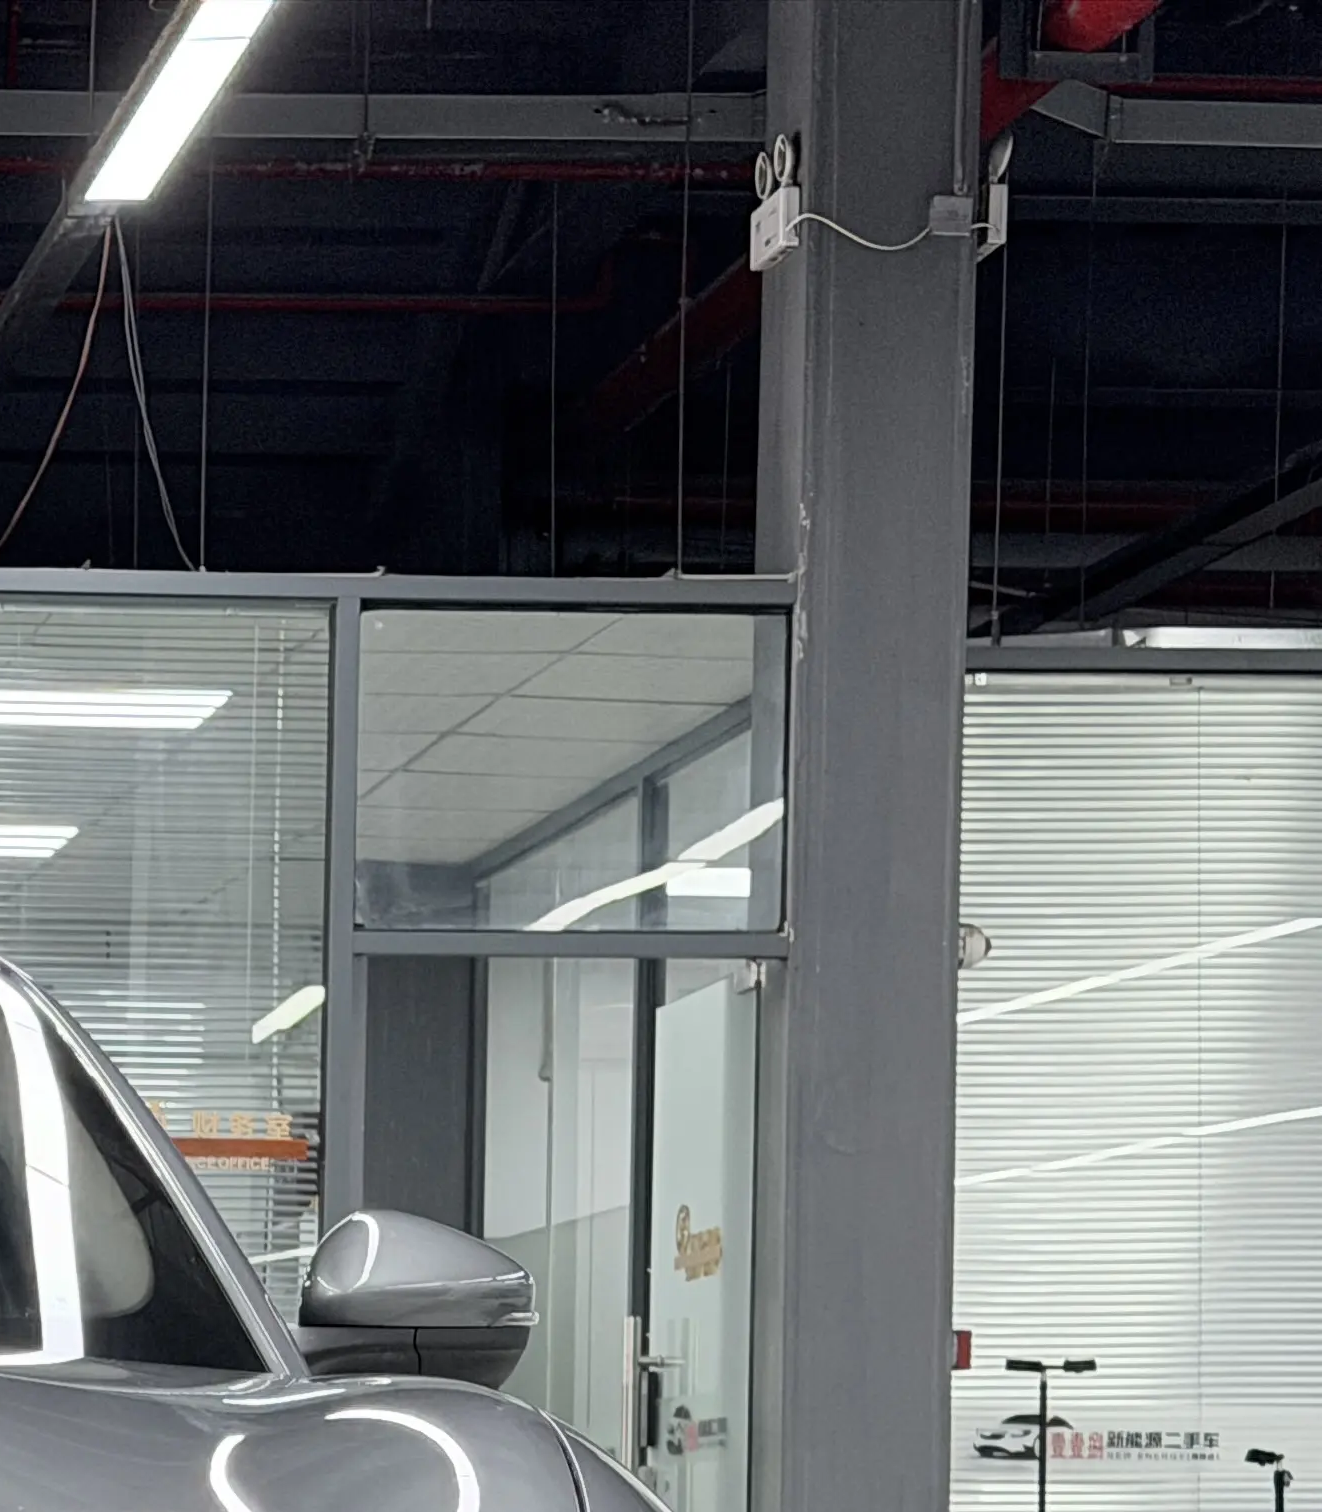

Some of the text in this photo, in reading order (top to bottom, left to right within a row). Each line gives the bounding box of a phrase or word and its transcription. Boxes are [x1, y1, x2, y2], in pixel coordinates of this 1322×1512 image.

[192, 1111, 293, 1140] 财务室
[1107, 1430, 1219, 1449] 新能源二手车
